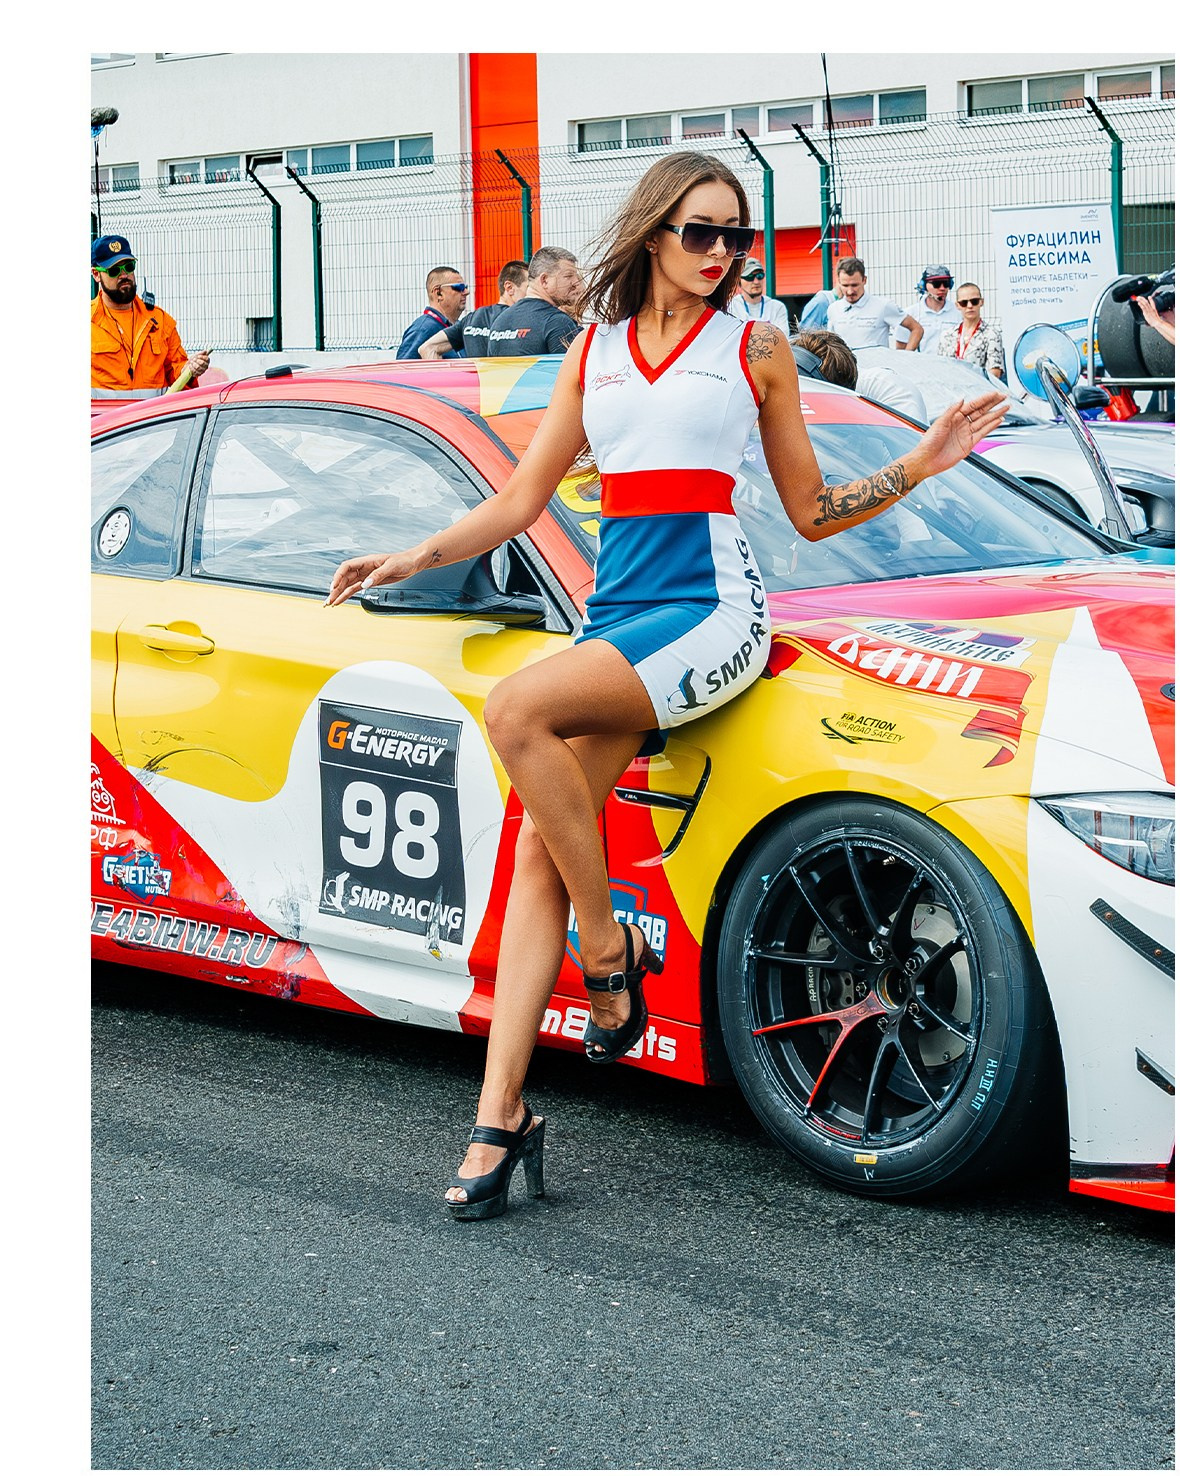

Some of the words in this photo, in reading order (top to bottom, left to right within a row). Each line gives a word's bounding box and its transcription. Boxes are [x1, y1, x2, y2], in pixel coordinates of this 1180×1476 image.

[1006, 230, 1101, 248] ФУРАЦИЛИН
[1008, 250, 1091, 267] АВЕКСИМА
[1009, 273, 1047, 284] ШИПУЧИЕ
[1049, 272, 1088, 282] ТАБЛЕТКИ
[463, 326, 490, 337] Capita
[687, 370, 728, 384] YOKOHAMA
[705, 640, 754, 696] SMP
[855, 715, 897, 732] ACTION
[375, 726, 419, 742] МОТОРНОЕ
[847, 723, 873, 736] ROAD
[872, 728, 905, 743] SAFETY
[339, 781, 440, 879] 98
[349, 885, 390, 912] SMP
[390, 894, 463, 930] RACING
[91, 902, 278, 969] E4BMW.RU
